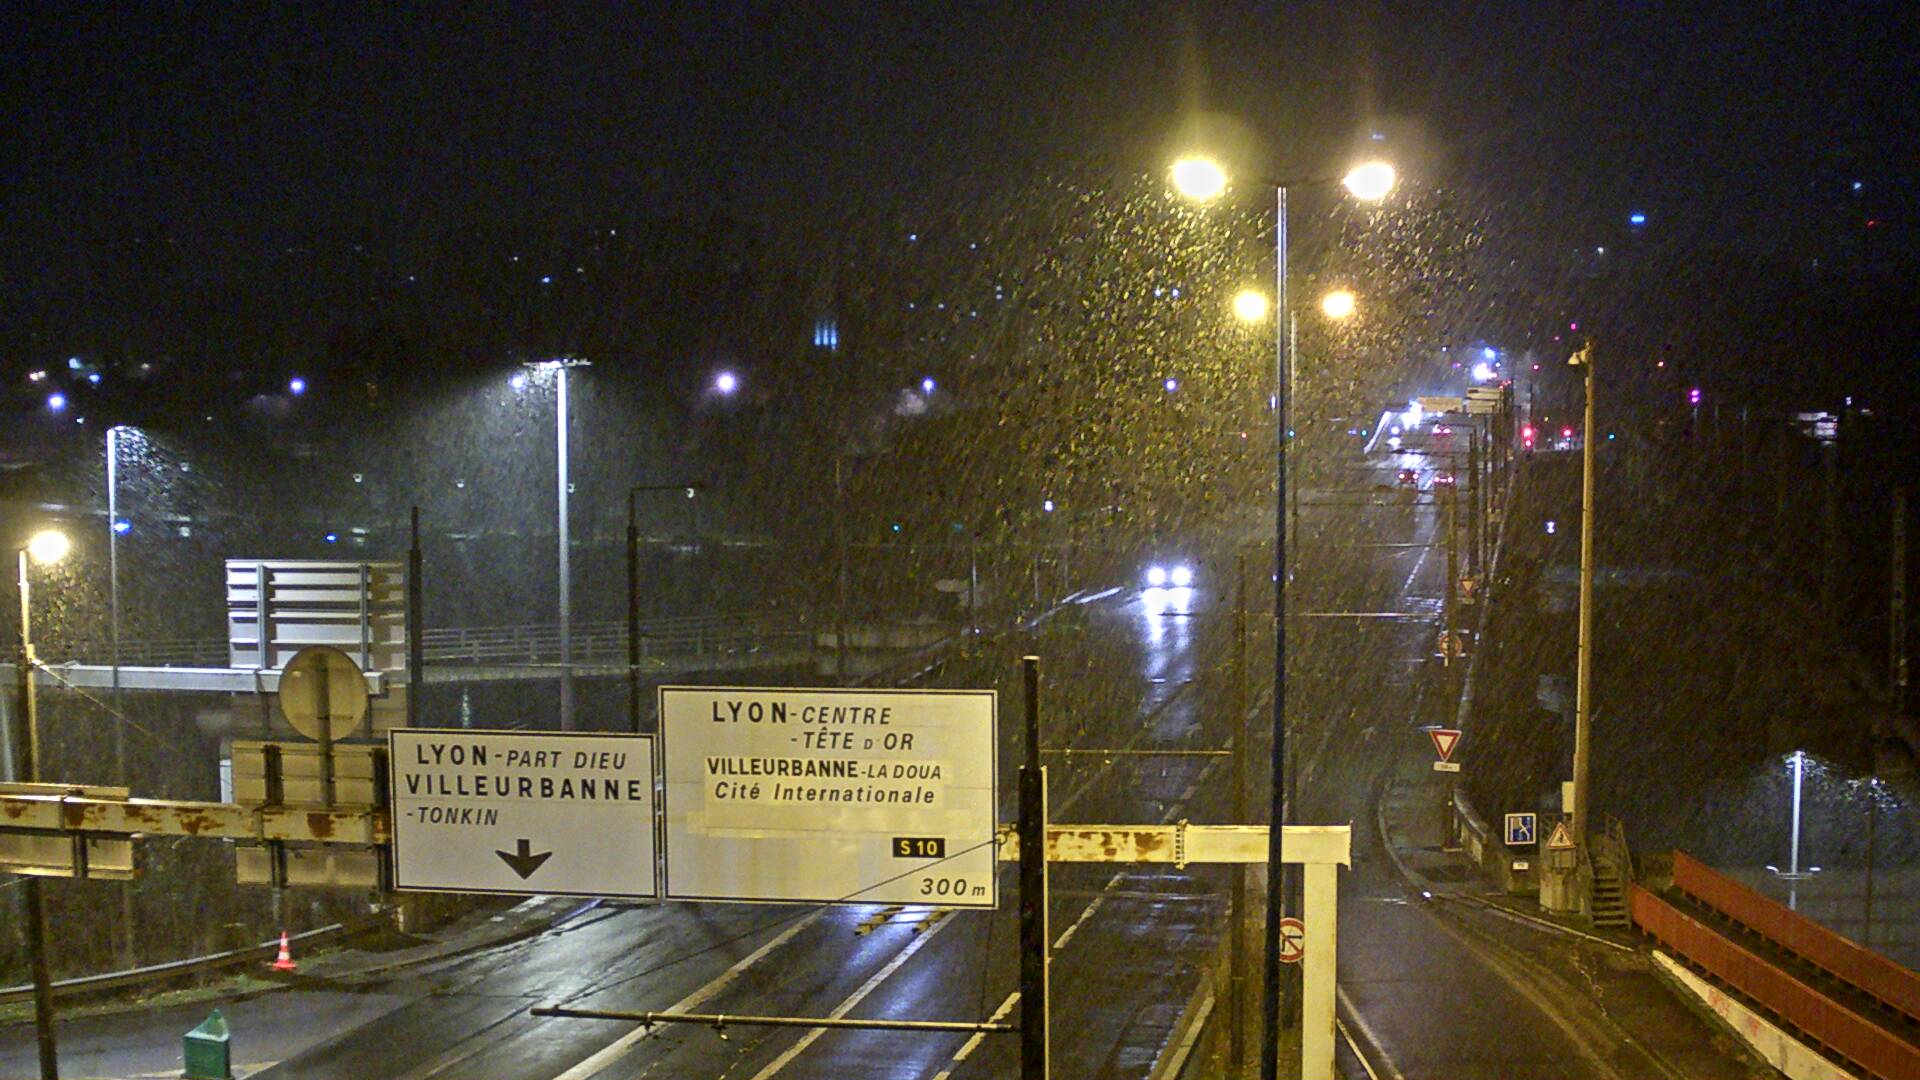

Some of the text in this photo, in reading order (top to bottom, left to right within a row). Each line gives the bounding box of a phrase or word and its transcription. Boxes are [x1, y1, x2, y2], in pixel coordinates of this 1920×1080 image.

[574, 752, 627, 770] DIEU
[893, 764, 941, 780] DOUA
[406, 774, 642, 800] VILLEURBANNE
[715, 782, 935, 804] Cité Internationale
[921, 878, 986, 896] 300 m
